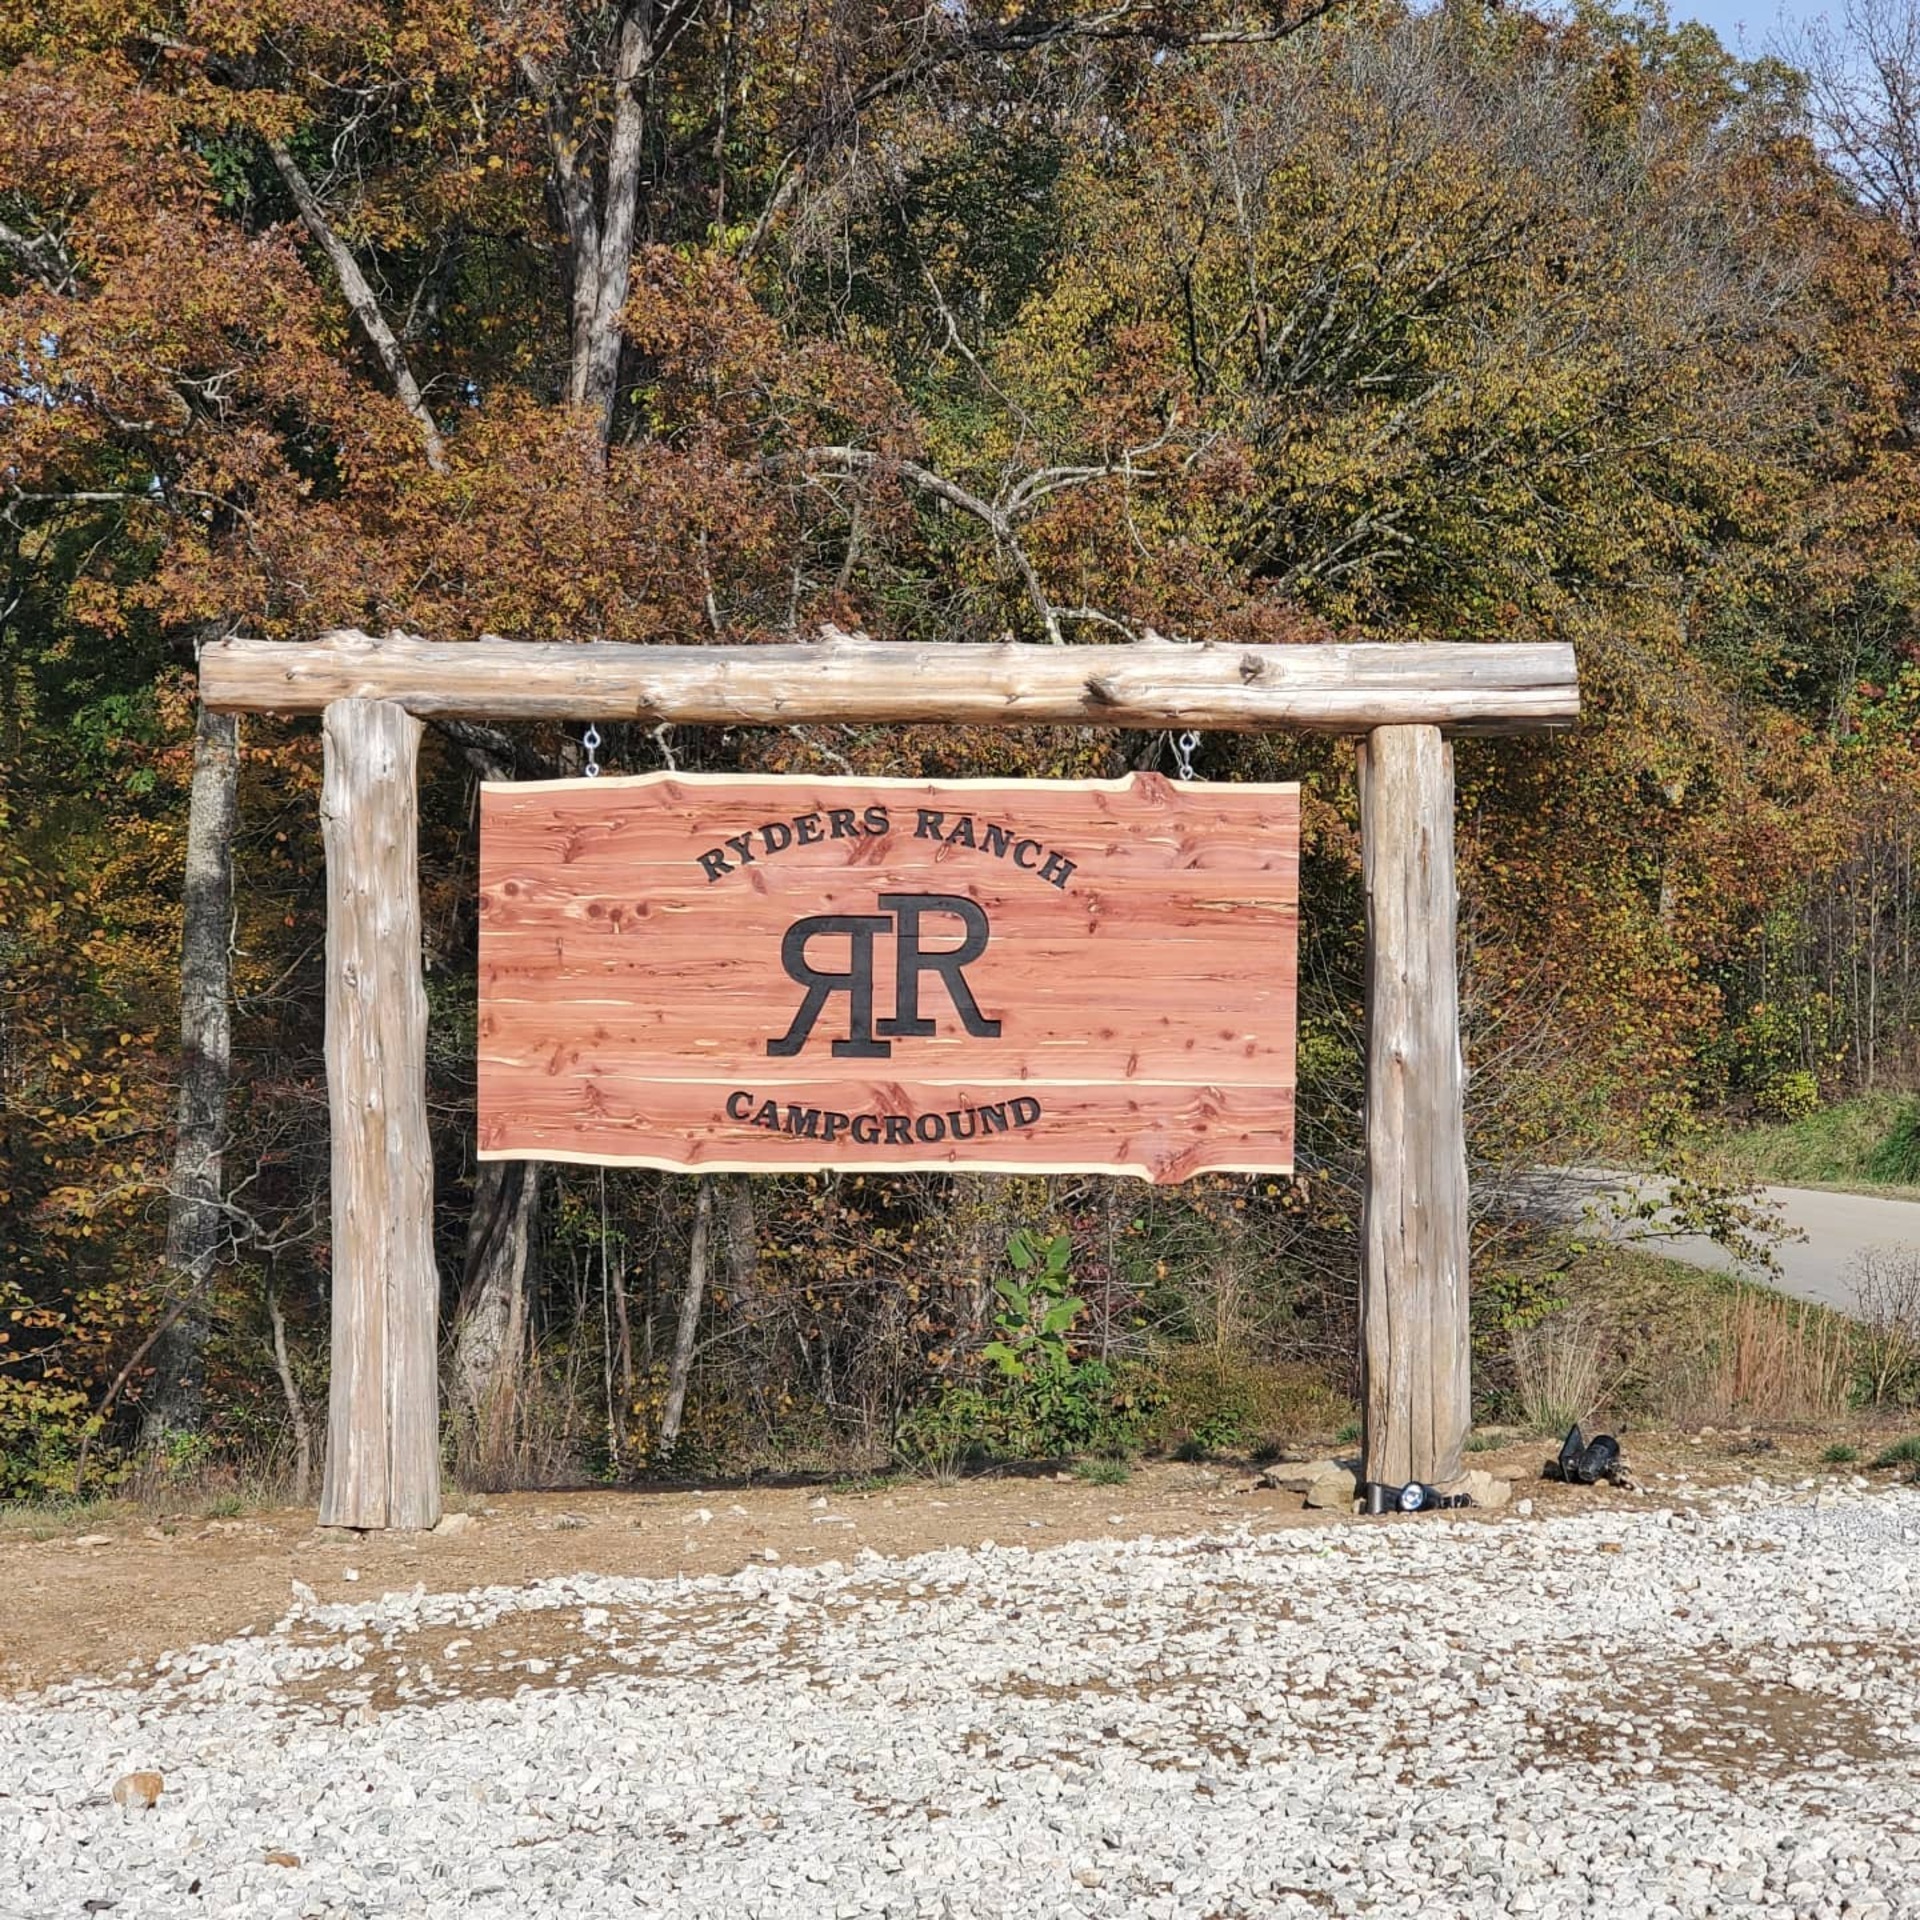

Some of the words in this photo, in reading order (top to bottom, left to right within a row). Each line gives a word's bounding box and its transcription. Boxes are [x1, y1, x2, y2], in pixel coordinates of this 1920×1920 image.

[698, 806, 889, 883] RYDERS
[915, 808, 1077, 891] RANCH
[726, 1090, 1041, 1146] CAMPGROUND
